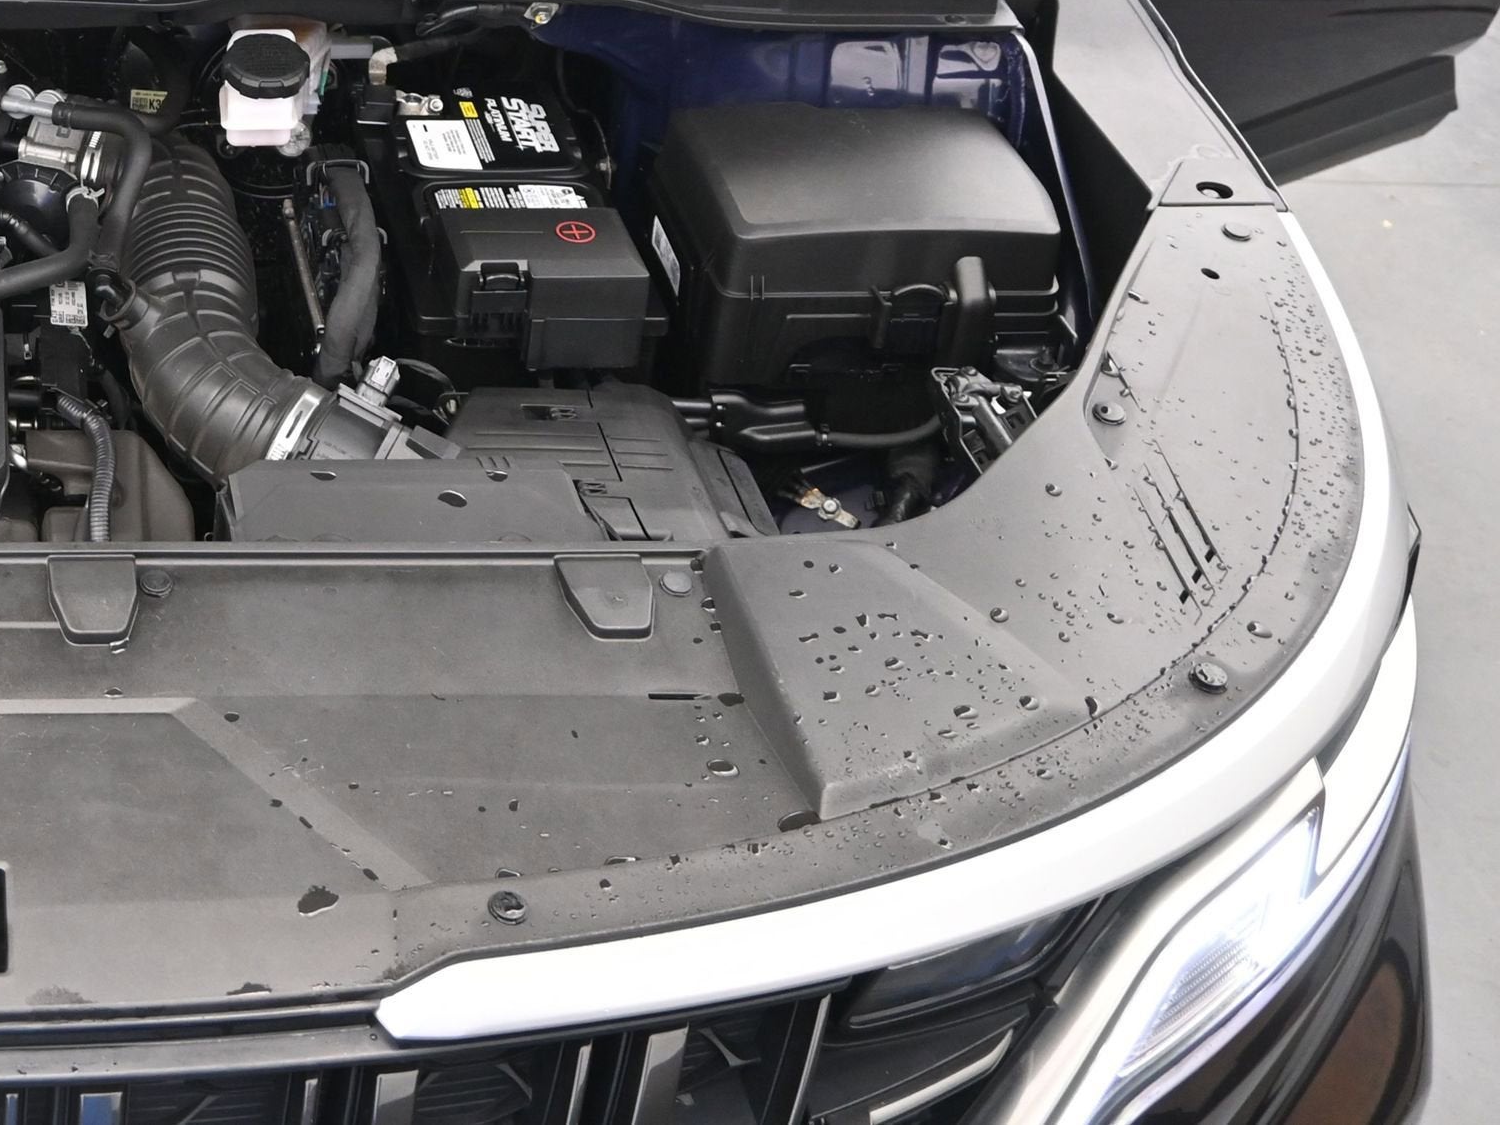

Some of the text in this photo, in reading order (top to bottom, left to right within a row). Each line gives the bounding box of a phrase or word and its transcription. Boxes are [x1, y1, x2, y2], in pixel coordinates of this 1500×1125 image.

[484, 98, 513, 142] PLATINUM
[501, 96, 543, 153] START
[526, 103, 560, 152] SUPER
